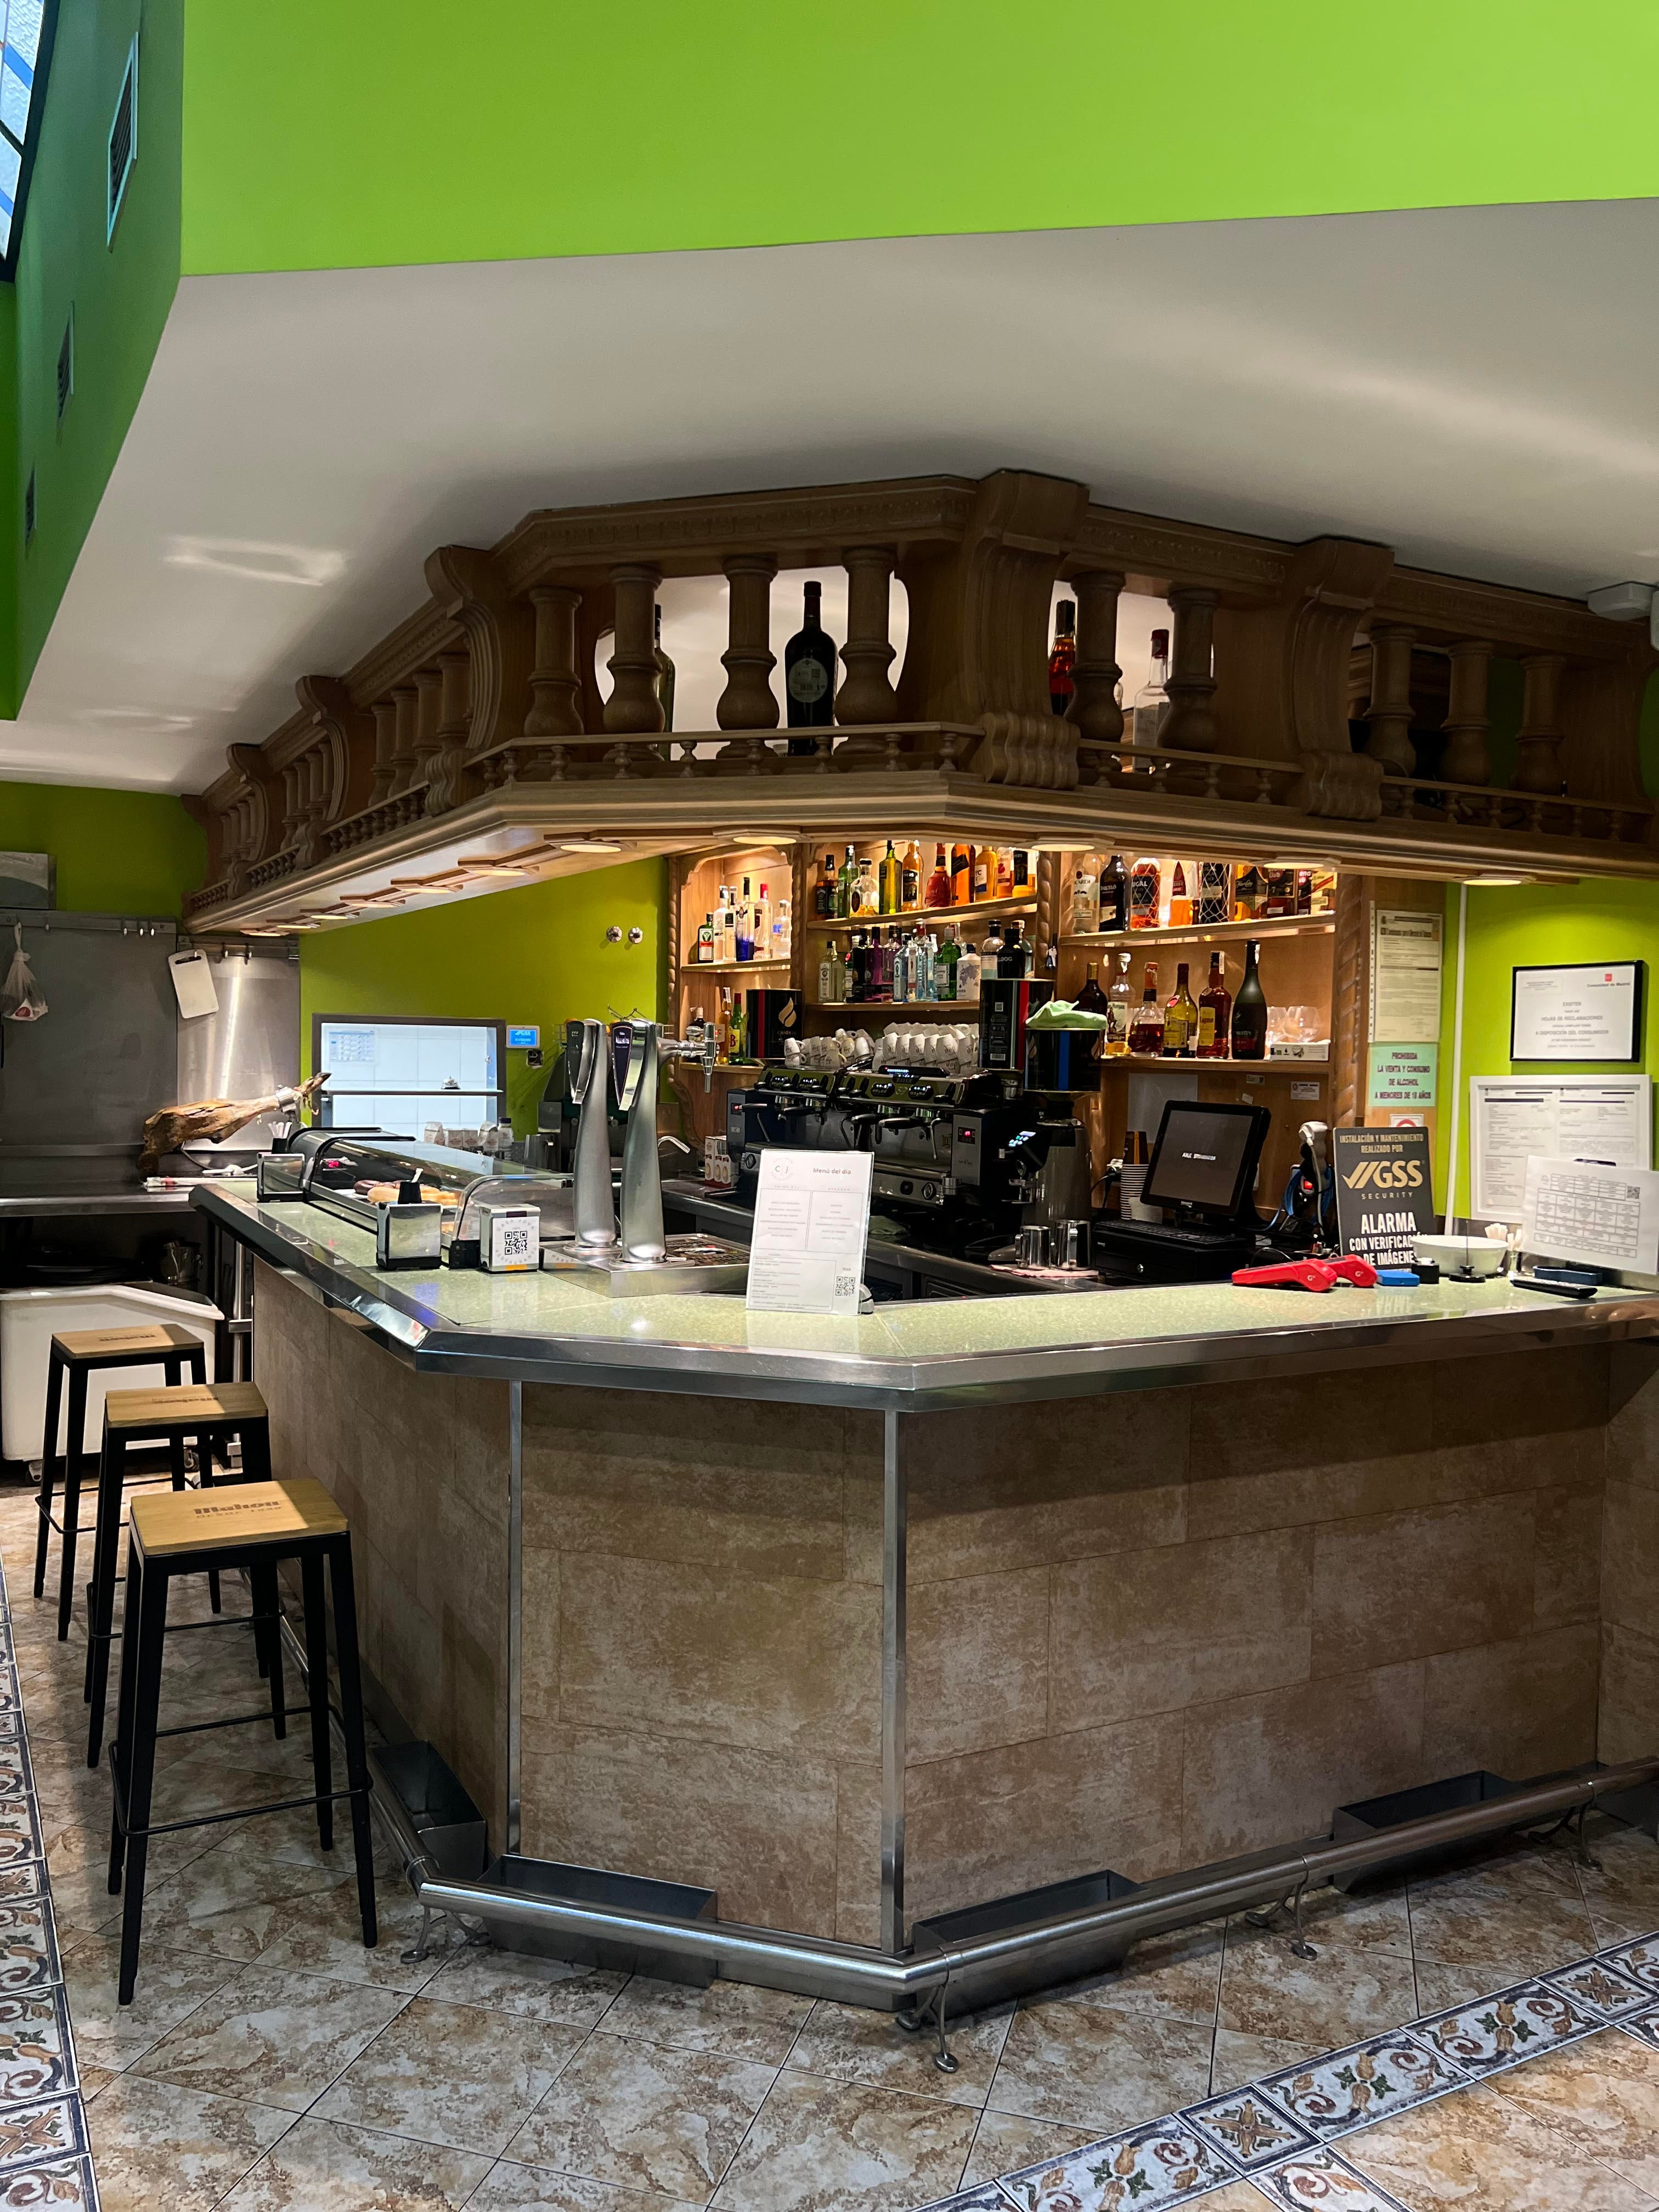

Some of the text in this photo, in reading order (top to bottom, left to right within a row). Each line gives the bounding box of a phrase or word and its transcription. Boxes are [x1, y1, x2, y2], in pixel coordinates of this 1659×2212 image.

[1419, 1090, 1431, 1099] AÑOS
[1340, 1133, 1374, 1143] INSTALACIÓN
[1380, 1133, 1424, 1142] MANTENIMIENTO
[1361, 1144, 1403, 1153] REALIZADO POR
[1373, 1160, 1423, 1188] GSS
[1361, 1192, 1413, 1200] SECURITY
[1361, 1211, 1417, 1234] ALARMA
[1349, 1232, 1427, 1251] CON VERIFICAC
[1363, 1249, 1417, 1266] DE IMÁGENE
